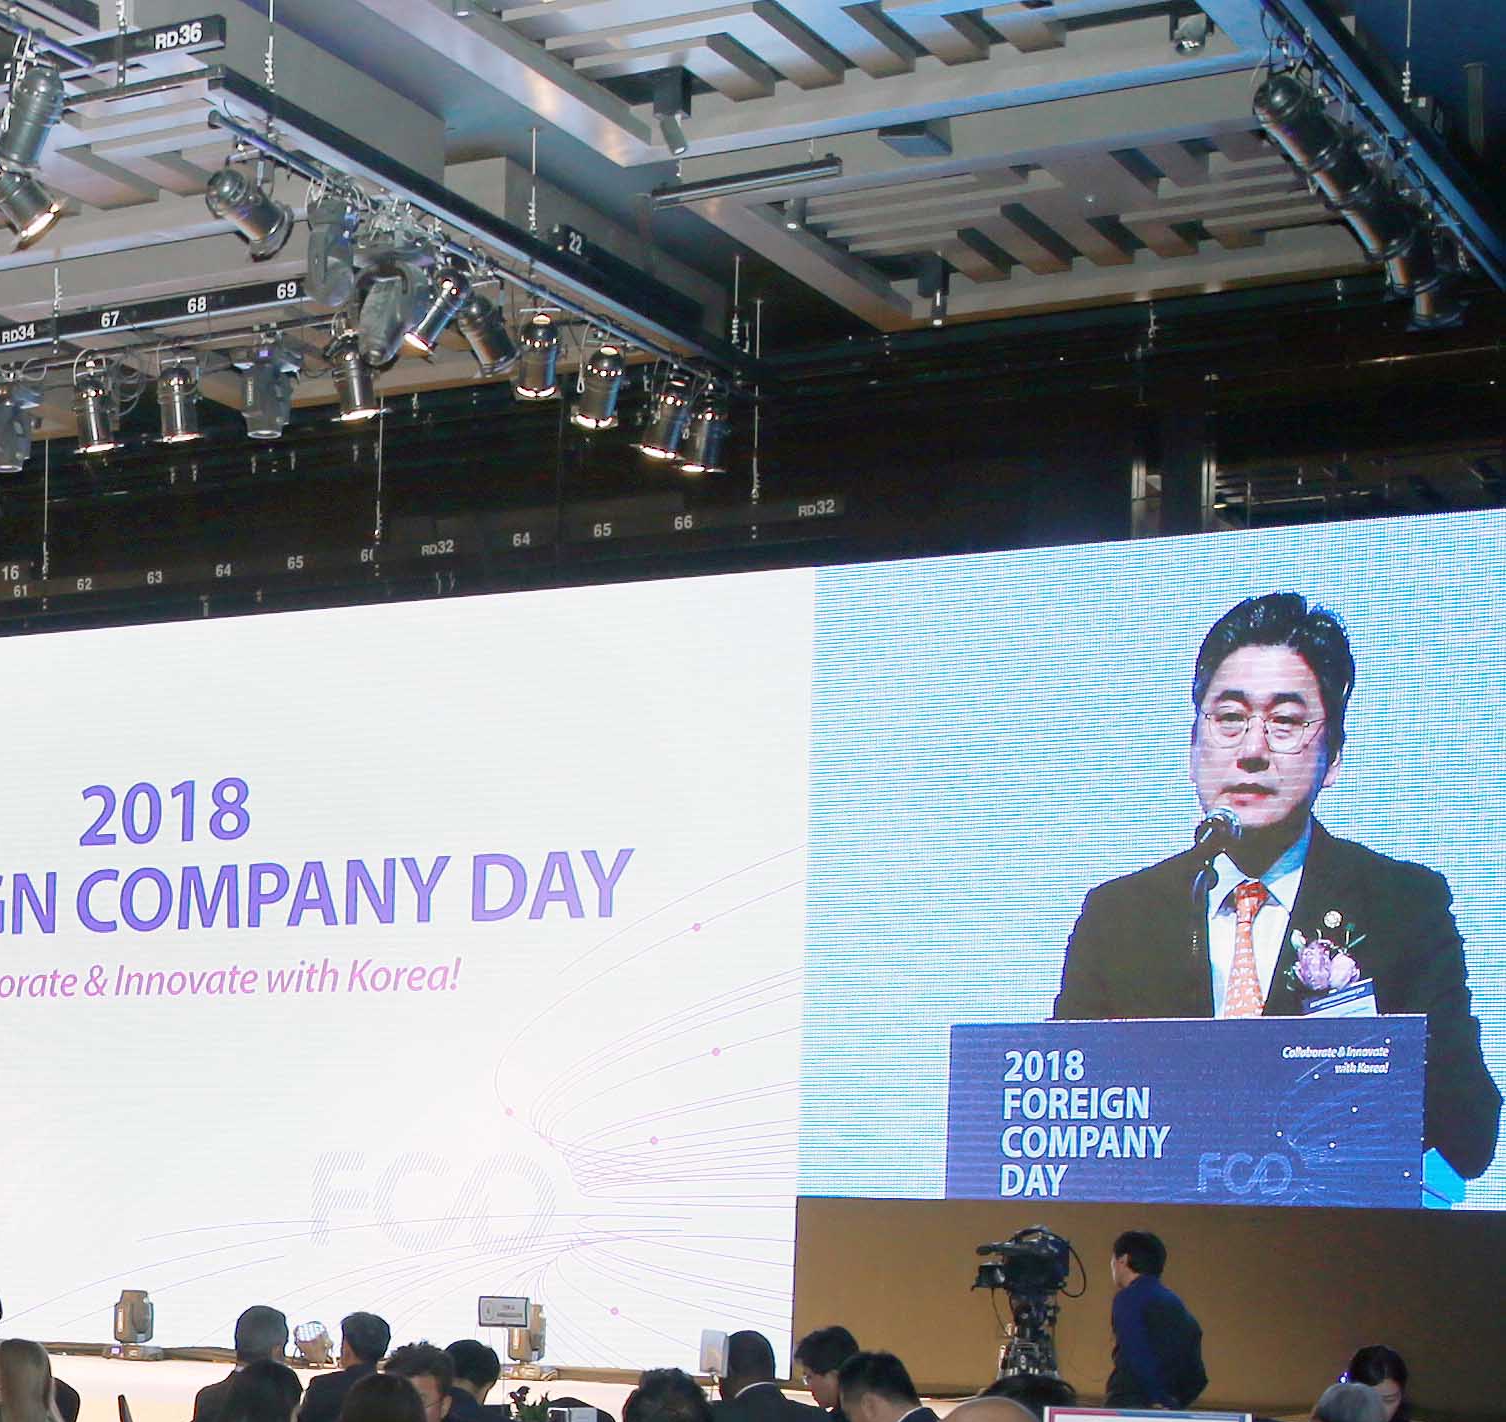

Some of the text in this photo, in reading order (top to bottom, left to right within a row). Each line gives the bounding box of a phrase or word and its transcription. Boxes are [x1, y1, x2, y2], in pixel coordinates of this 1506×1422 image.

[154, 22, 203, 51] RD36
[567, 230, 584, 255] 22
[276, 281, 298, 299] 69
[187, 295, 208, 313] 68
[100, 310, 120, 329] 67
[1, 323, 37, 344] RD34
[797, 499, 836, 518] RD32
[593, 523, 612, 538] 65
[674, 514, 693, 530] 66
[421, 539, 455, 557] RD32
[512, 532, 531, 547] 64
[214, 563, 233, 579] 64
[287, 555, 305, 570] 65
[1, 565, 20, 582] 16
[146, 569, 164, 585] 63
[13, 582, 29, 599] 61
[76, 576, 93, 592] 62
[79, 777, 252, 847] 2018
[75, 854, 451, 936] COMPANY
[470, 847, 635, 924] DAY
[84, 964, 109, 998] &
[114, 961, 256, 998] Innovate
[266, 959, 339, 995] with
[346, 956, 463, 993] Korea!
[1003, 1048, 1085, 1083] 2018
[1002, 1086, 1152, 1121] FOREIGN
[1000, 1125, 1172, 1159] COMPANY
[1000, 1163, 1069, 1198] DAY
